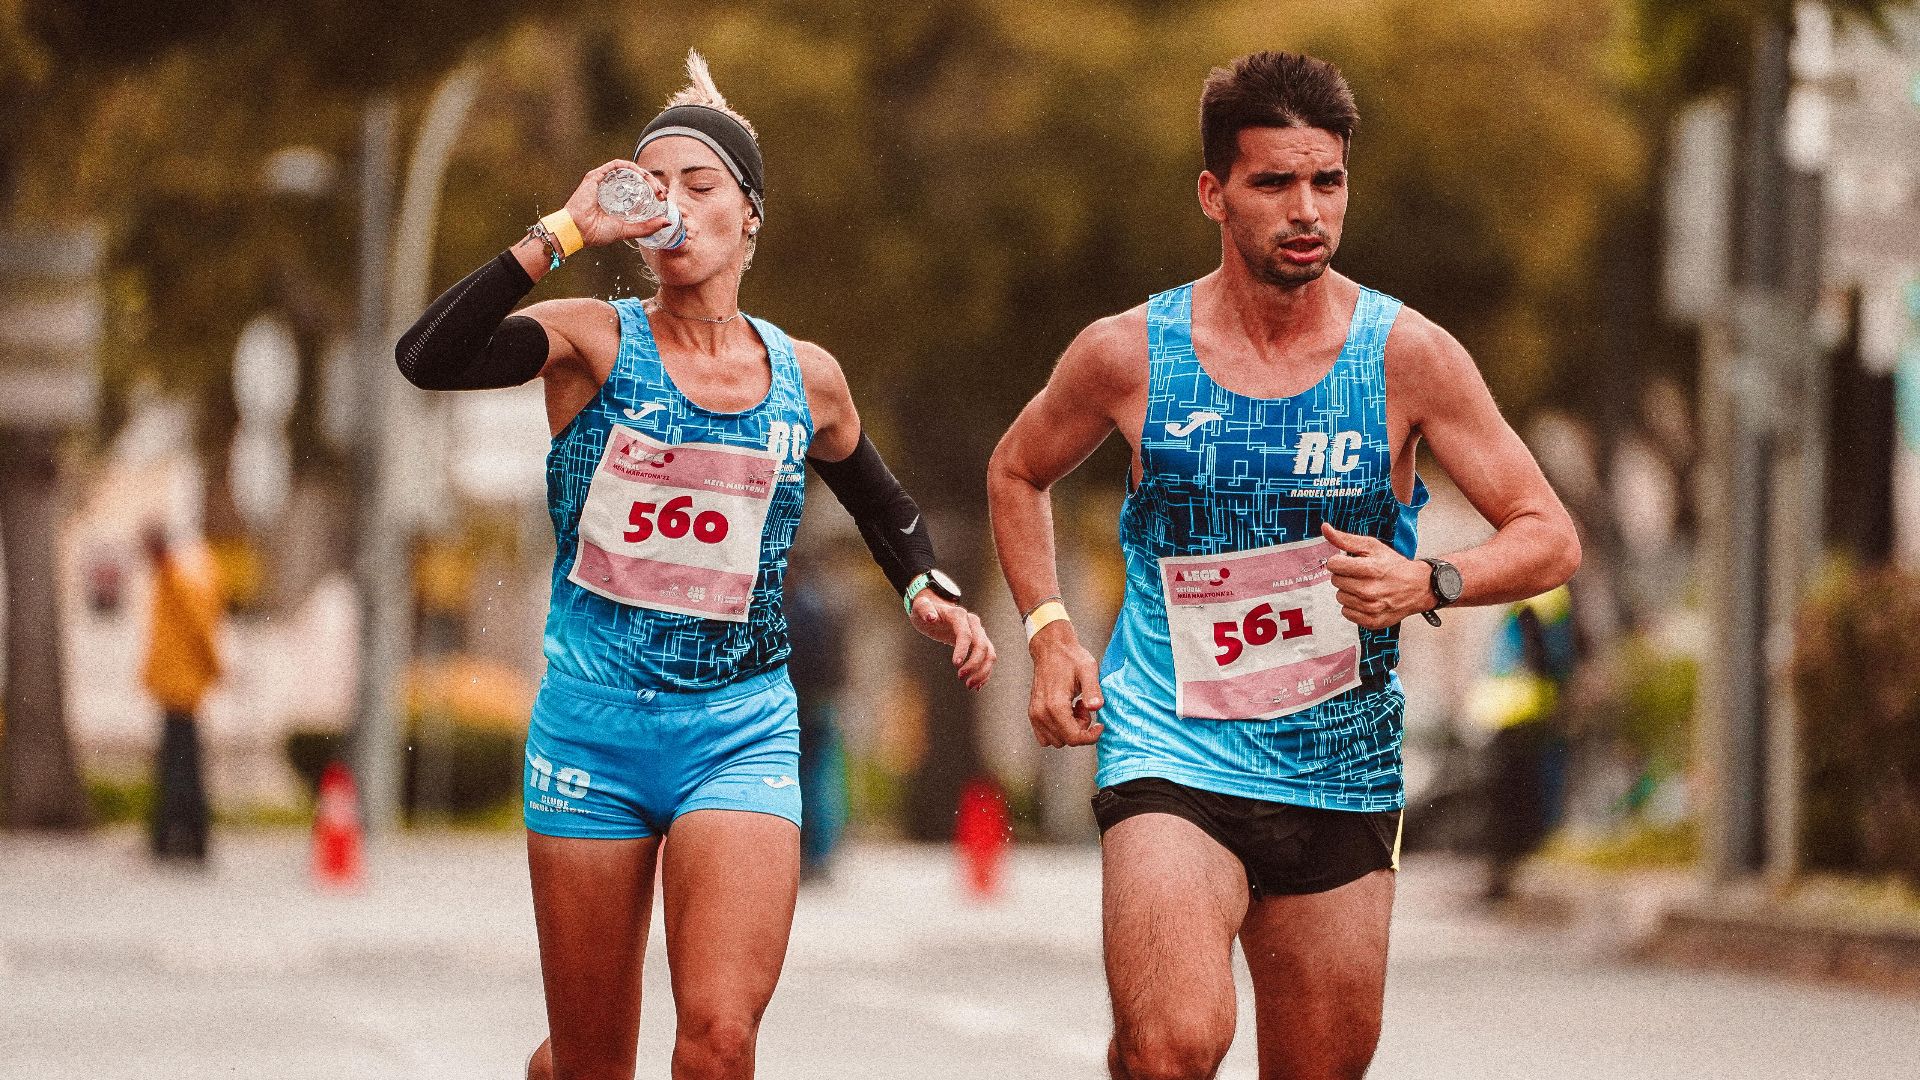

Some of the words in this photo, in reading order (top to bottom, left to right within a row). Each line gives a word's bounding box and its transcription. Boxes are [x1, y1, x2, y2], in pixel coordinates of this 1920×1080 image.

[1292, 430, 1362, 475] RC
[1313, 477, 1341, 487] CLUBE
[623, 495, 729, 544] 560
[1272, 579, 1294, 588] MEIA
[1295, 570, 1331, 584] MARATO
[1212, 602, 1313, 667] 561
